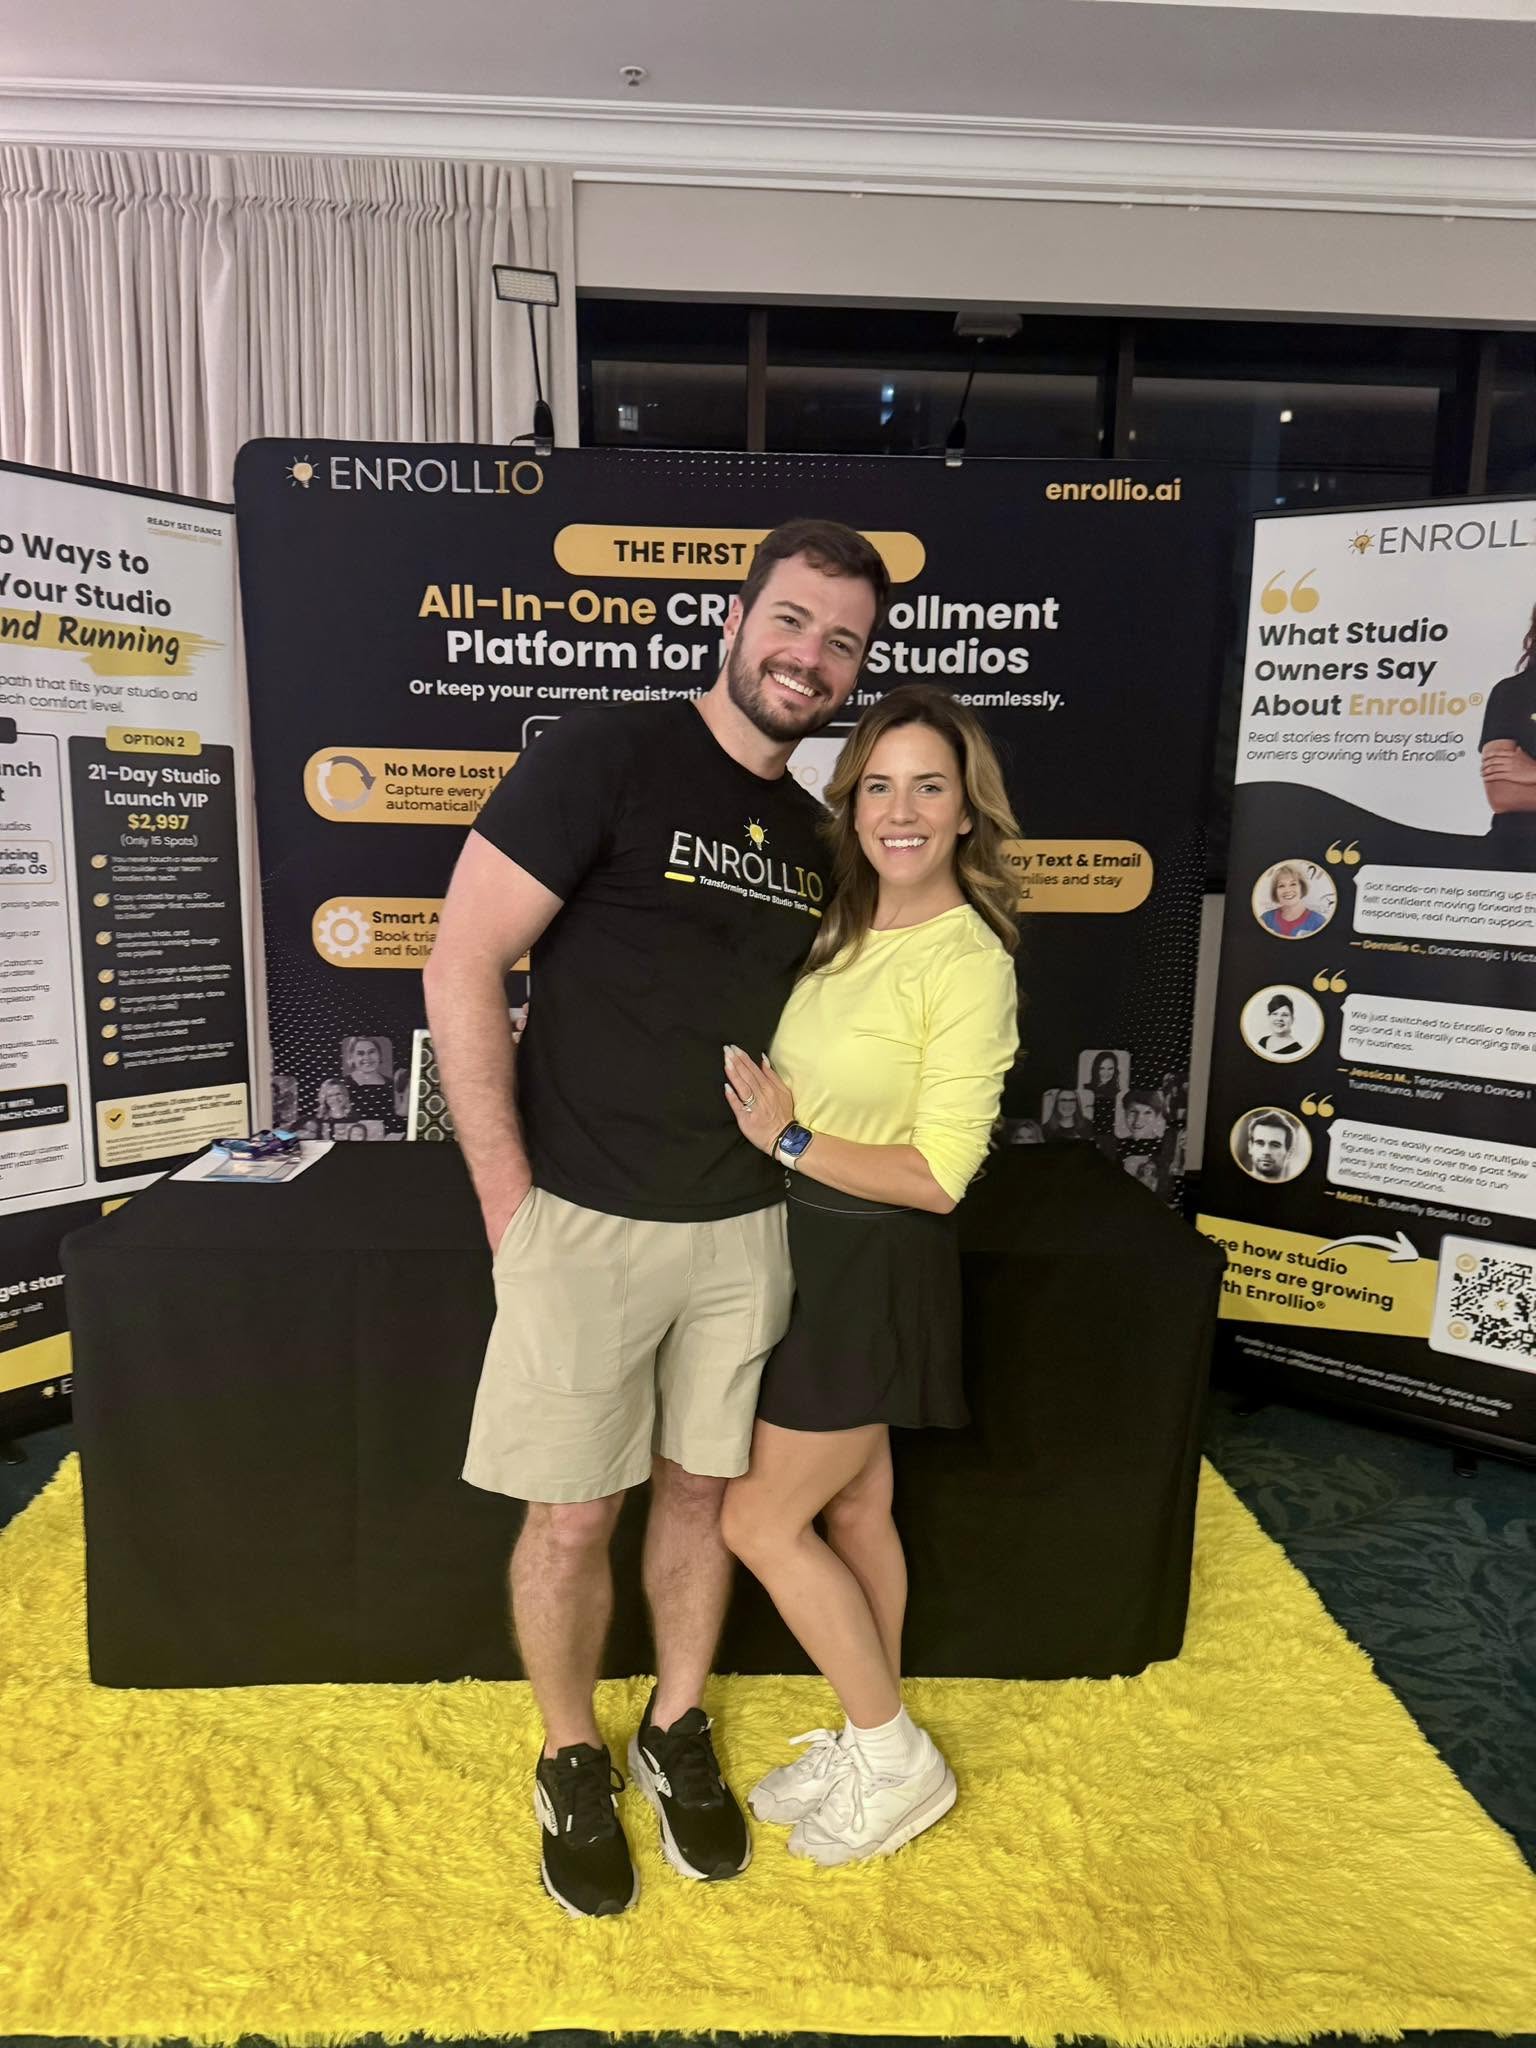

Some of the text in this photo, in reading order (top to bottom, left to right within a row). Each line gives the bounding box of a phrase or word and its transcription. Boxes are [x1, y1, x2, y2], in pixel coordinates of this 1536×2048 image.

[330, 456, 544, 495] ENROLLIO
[1045, 478, 1181, 502] enrollio.ai
[177, 522, 192, 530] SET
[194, 525, 222, 536] DANCE
[21, 533, 112, 574] Ways
[119, 549, 149, 575] to
[614, 539, 665, 563] THE
[673, 542, 747, 565] FIRST
[0, 573, 172, 617] Your Studio
[418, 583, 1060, 631] All-In-One CR ollment
[0, 610, 181, 666] nd Running
[1258, 617, 1448, 647] What Studio
[446, 629, 637, 669] Platform
[647, 634, 709, 670] for
[866, 637, 1030, 674] Studios
[1254, 657, 1437, 687] Owners Say
[36, 677, 65, 691] that
[70, 679, 90, 692] fits
[93, 685, 123, 696] your
[127, 686, 169, 699] studio
[172, 690, 197, 702] and
[409, 679, 433, 695] Or
[436, 680, 485, 702] keep
[488, 685, 533, 702] your
[536, 685, 608, 701] current
[612, 685, 709, 701] registrati
[0, 693, 124, 713] ech comfort level.
[1251, 694, 1342, 717] About
[123, 733, 185, 747] OPTION 2
[1248, 730, 1464, 747] Real stories from busy studio
[1247, 750, 1299, 762] owners
[1302, 750, 1363, 765] growing
[1366, 749, 1399, 762] with
[88, 764, 221, 787] 21-Day Studio
[384, 763, 408, 778] No
[412, 764, 456, 779] More
[460, 765, 495, 780] Lost
[104, 790, 209, 808] Launch VIP
[385, 783, 485, 799] Capture every
[127, 813, 190, 832] $2,997
[120, 834, 199, 847] (Only 15 Spots)
[0, 849, 39, 863] ricing
[669, 830, 823, 902] ENROLLIO
[1037, 853, 1141, 867] Text & Email
[28, 864, 48, 875] OS
[1062, 874, 1123, 888] and stay
[1385, 883, 1438, 895] hands-on
[1440, 887, 1464, 897] help
[1467, 888, 1506, 900] setting
[1508, 891, 1523, 900] up
[699, 876, 808, 911] Transforming Dance Studio Tech
[1381, 896, 1432, 908] confident
[1433, 899, 1476, 913] moving
[1478, 902, 1522, 914] forward
[372, 911, 426, 924] Smart
[1361, 908, 1420, 921] responsive,
[1422, 912, 1443, 921] real
[1445, 915, 1486, 925] human
[375, 930, 410, 942] Book
[374, 944, 402, 956] and
[1428, 944, 1501, 962] Dancemajic
[1351, 1010, 1526, 1038] We just switched to Enrollio a few
[1348, 1036, 1414, 1051] my business.
[1349, 1023, 1370, 1034] ago
[1372, 1025, 1393, 1036] and
[1395, 1028, 1402, 1037] it
[1415, 1029, 1453, 1044] literally
[1454, 1035, 1508, 1052] changing
[1510, 1041, 1531, 1052] the
[1414, 1075, 1483, 1094] Terpsichore
[1484, 1084, 1524, 1099] Dance
[1342, 1129, 1530, 1167] Enrollio has easily made us multiple
[1339, 1155, 1510, 1191] years just from being able to run
[1389, 1151, 1431, 1164] revenue
[1433, 1157, 1457, 1168] over
[1459, 1161, 1477, 1172] the
[1479, 1164, 1504, 1178] past
[1383, 1175, 1447, 1193] promotions.
[1377, 1198, 1425, 1217] Butterfly
[1426, 1207, 1459, 1221] Ballet
[1243, 1240, 1283, 1261] how
[1287, 1252, 1348, 1275] studio
[0, 1280, 29, 1302] get
[1222, 1280, 1242, 1296] th
[1228, 1262, 1394, 1311] ners are growing
